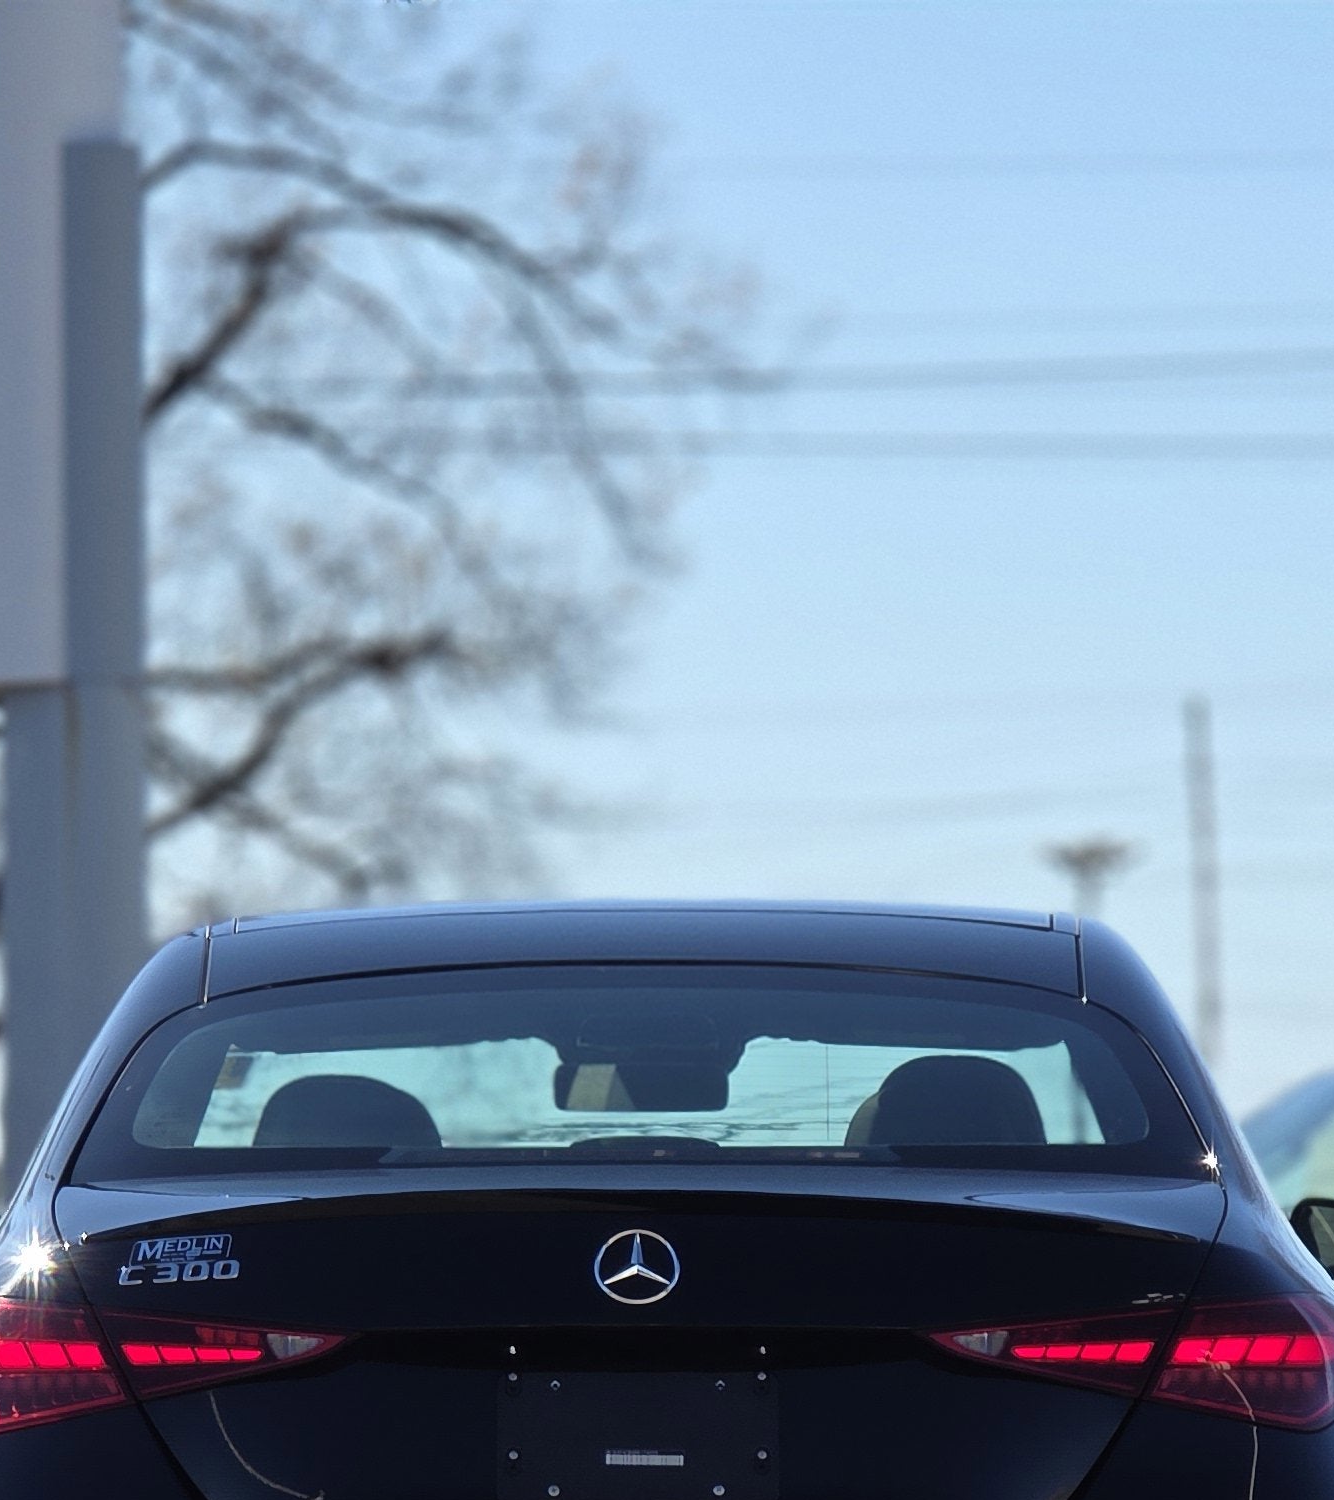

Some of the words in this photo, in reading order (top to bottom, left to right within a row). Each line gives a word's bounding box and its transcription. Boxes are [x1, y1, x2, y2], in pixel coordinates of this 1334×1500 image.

[137, 1236, 224, 1261] MEDLIN
[119, 1265, 146, 1285] C
[153, 1260, 240, 1283] 300
